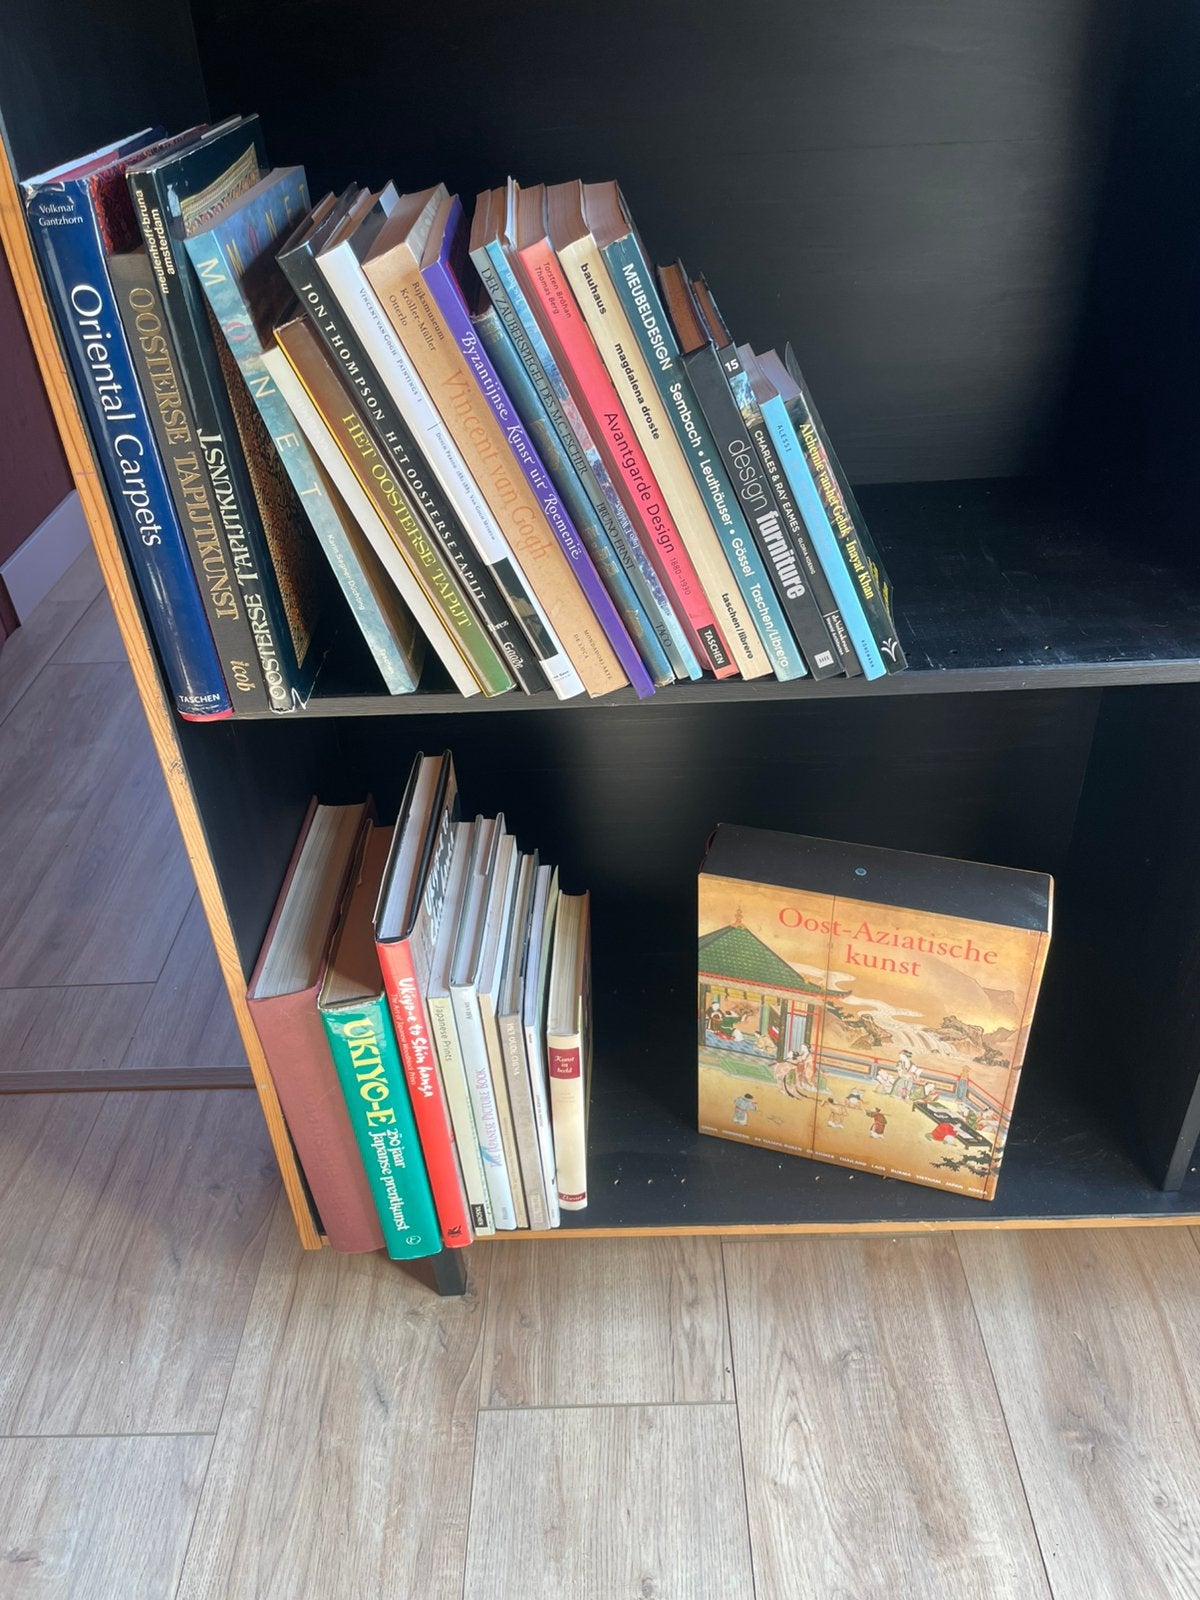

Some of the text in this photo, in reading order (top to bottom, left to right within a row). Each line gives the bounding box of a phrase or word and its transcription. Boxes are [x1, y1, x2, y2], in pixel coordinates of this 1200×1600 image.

[38, 215, 84, 227] Gantzhorn
[39, 202, 75, 215] Volkmar
[135, 190, 170, 294] meulenhoff-bruna
[151, 208, 175, 276] amsterdam
[534, 266, 552, 298] Thomas
[543, 260, 559, 289] Torsten
[389, 294, 408, 327] Otterlo
[400, 288, 437, 352] Kröller-Müller
[411, 281, 445, 342] Rijksmuseum
[480, 267, 500, 295] DER
[497, 297, 545, 391] ZAUBERSPIEGEL
[540, 387, 556, 409] DES
[561, 431, 590, 475] ESCHER
[580, 263, 607, 316] bauhaus
[614, 343, 645, 405] magdalena
[641, 401, 660, 440] droste
[724, 359, 740, 372] 15
[71, 284, 162, 547] Oriental Carpets
[300, 282, 488, 602] JON THOMPSON HET OOSTERSE TAPIJT
[461, 331, 508, 421] Byzantijnse
[506, 425, 535, 470] Kunst
[543, 493, 583, 560] Roemenië
[776, 424, 792, 454] ALESSI
[128, 287, 241, 621] OOSTERSE TAPIJTKUNST
[440, 367, 555, 561] Vincent van Gogh
[604, 413, 651, 502] Avantgarde
[646, 504, 675, 554] Design
[622, 263, 789, 668] MEUBELDESIGN Sembach Leuthäuser Gössel Taschen/Librero
[754, 430, 778, 475] CHARLES
[774, 480, 789, 500] RAY
[782, 498, 800, 534] EAMES
[341, 413, 472, 629] HET OOSTERSE TAPIJT
[596, 502, 637, 570] BRUNO ERNST
[728, 439, 806, 600] design furniture
[799, 423, 824, 472] Alchemie
[819, 469, 832, 487] van
[832, 504, 852, 537] Geluk
[845, 540, 864, 573] Inayat
[858, 570, 875, 600] Khan
[197, 428, 287, 701] OOSTERSE TAPIJTKUNST
[655, 622, 673, 648] TACO
[703, 630, 725, 665] TASCHEN
[179, 693, 220, 704] TASCHEN
[230, 660, 257, 693] icob
[778, 907, 998, 965] Oost-Aziatische
[846, 944, 921, 977] kunst
[398, 977, 434, 1098] Ukiyo-e to Shin hanga
[435, 1005, 453, 1062] Japanese Prints
[343, 1017, 397, 1127] UKIYO-E
[474, 1067, 489, 1090] BOOK
[368, 1131, 411, 1232] Japanse prentkunst
[386, 1127, 407, 1169] 250 jaar
